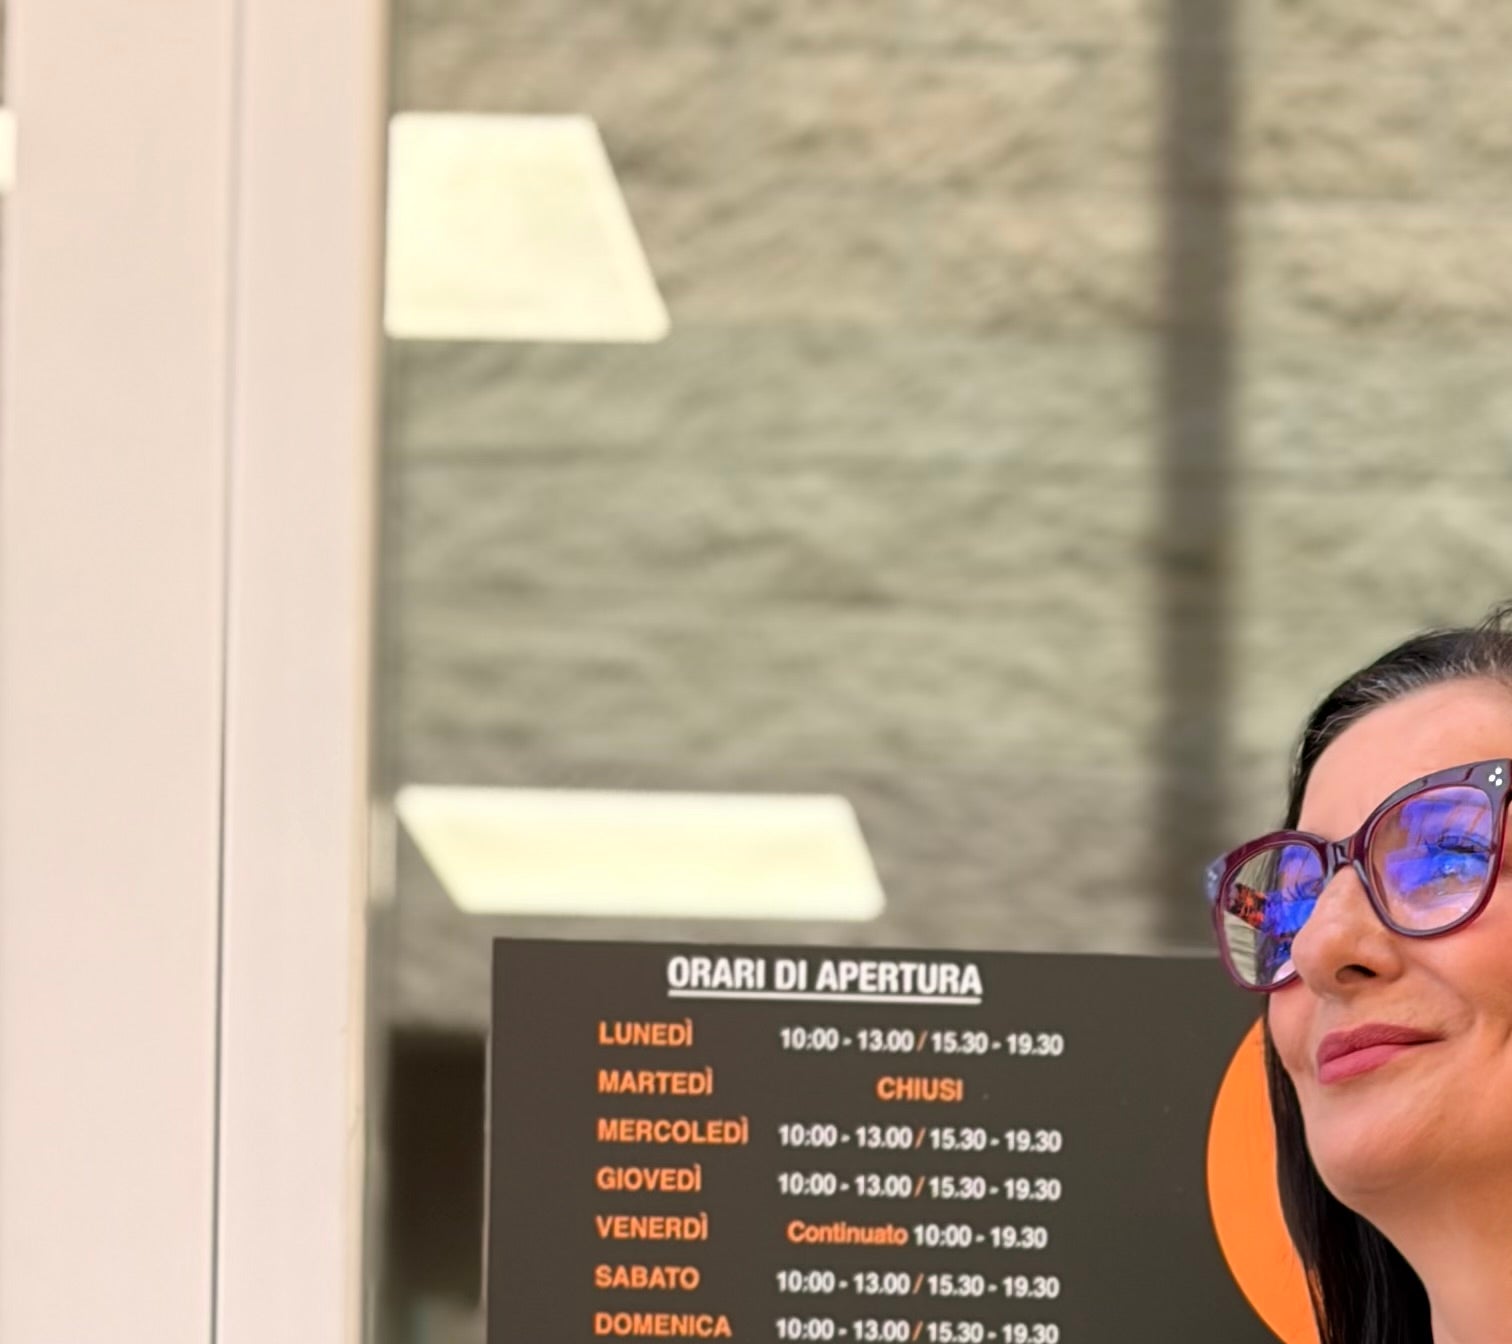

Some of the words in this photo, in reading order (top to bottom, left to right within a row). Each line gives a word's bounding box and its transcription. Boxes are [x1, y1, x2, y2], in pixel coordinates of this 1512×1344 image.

[666, 956, 766, 990] ORARI
[773, 959, 808, 992] DI
[814, 960, 984, 996] APERTURA
[597, 1017, 694, 1047] LUNEDÌ
[780, 1026, 840, 1051] 10:00
[857, 1028, 915, 1053] 13.00
[931, 1030, 989, 1055] 15.30
[1006, 1032, 1065, 1057] 19.30
[597, 1066, 714, 1096] MARTEDÌ
[875, 1075, 964, 1103] CHIUSI
[596, 1114, 749, 1145] MERCOLEDÌ
[778, 1123, 838, 1148] 10:00
[855, 1125, 914, 1150] 13.00
[929, 1127, 988, 1151] 15.30
[1004, 1129, 1063, 1153] 19.30
[595, 1163, 702, 1193] GIOVEDÌ
[777, 1171, 838, 1196] 10:00
[854, 1173, 913, 1198] 13.00
[928, 1175, 987, 1200] 15.30
[1003, 1177, 1062, 1202] 19.30
[594, 1211, 709, 1241] VENERDÌ
[786, 1219, 909, 1246] Continuato
[913, 1223, 973, 1248] 10:00
[989, 1225, 1048, 1249] 19.30
[594, 1263, 701, 1291] SABATO
[776, 1269, 836, 1294] 10:00
[853, 1271, 911, 1296] 13.00
[927, 1273, 985, 1297] 15.30
[1002, 1275, 1060, 1299] 19.30
[593, 1311, 733, 1339] DOMENICA
[775, 1317, 835, 1341] 10:00
[853, 1318, 911, 1343] 13.00
[926, 1321, 985, 1344] 15.30
